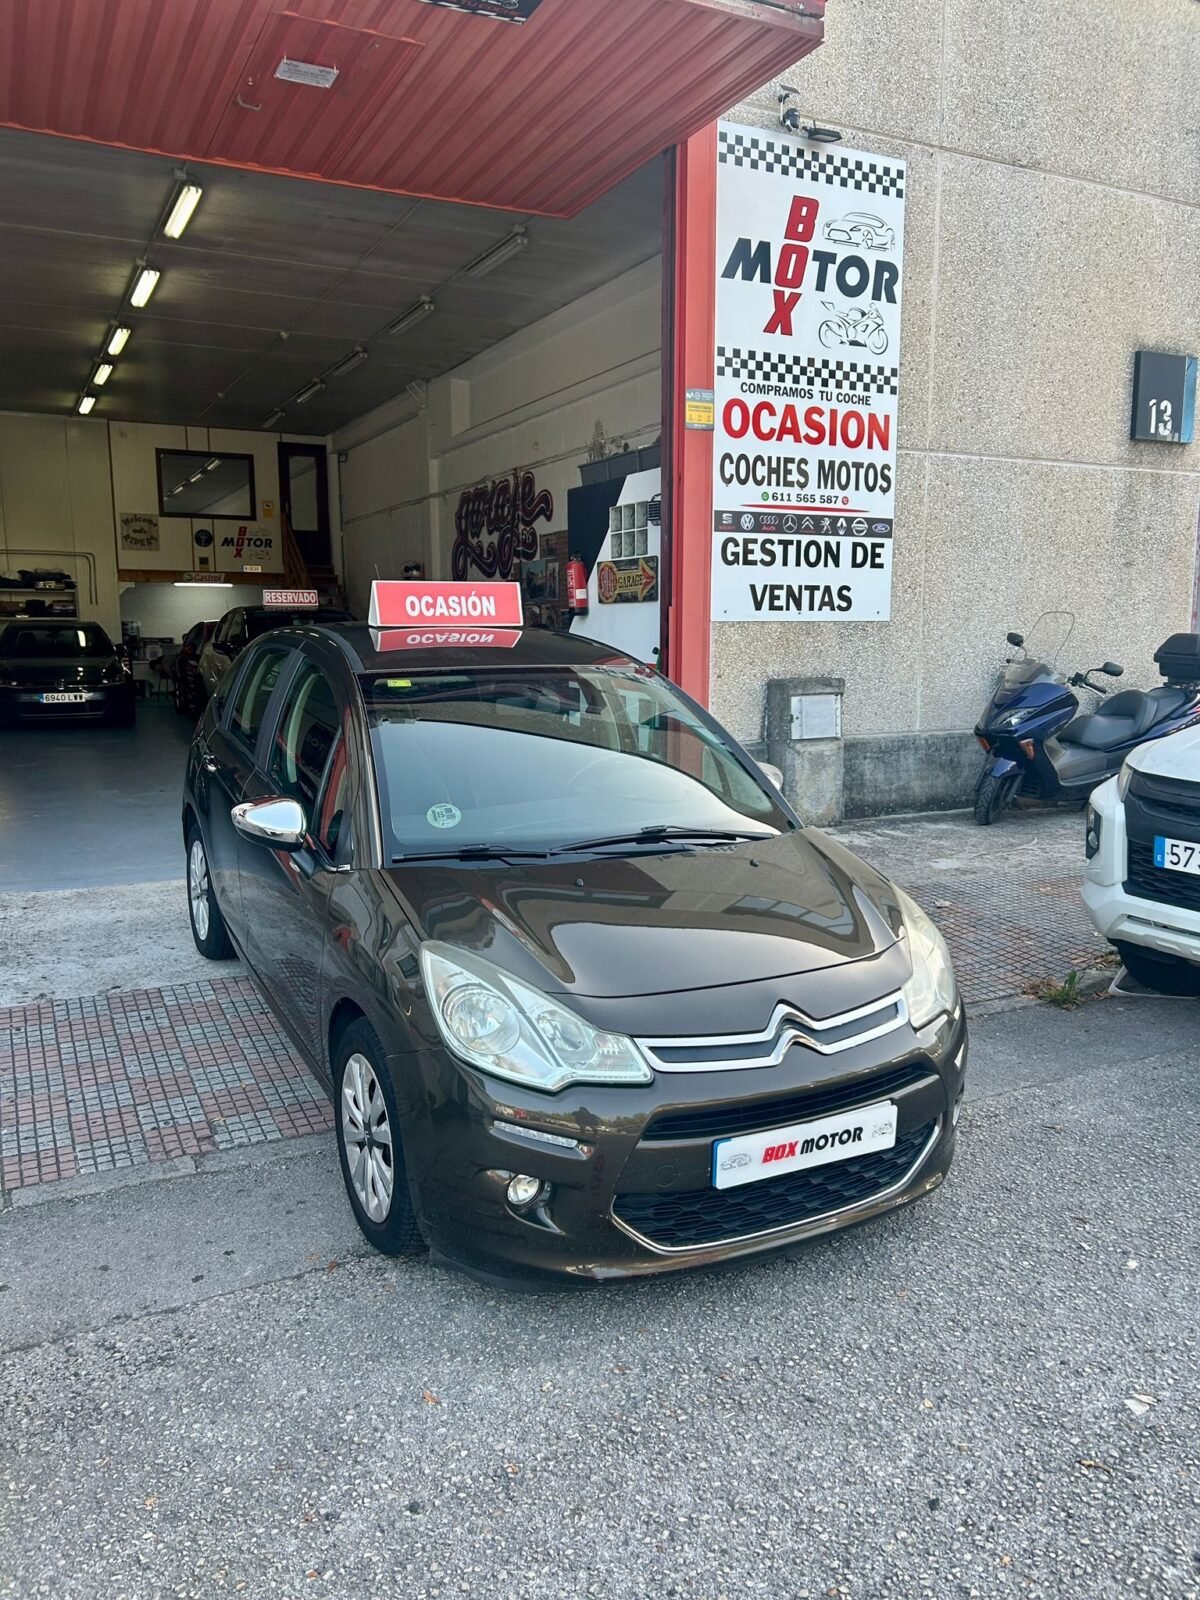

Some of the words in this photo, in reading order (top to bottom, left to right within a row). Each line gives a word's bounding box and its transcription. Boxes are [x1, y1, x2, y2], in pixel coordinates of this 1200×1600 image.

[721, 237, 899, 304] MOTOR
[763, 195, 820, 336] BOX
[740, 381, 814, 400] COMPRAMOS
[819, 390, 833, 402] TU
[836, 392, 871, 406] COCHE
[722, 398, 891, 451] OCASION
[1149, 399, 1172, 435] 13
[719, 452, 809, 489] COCHES
[817, 459, 892, 494] MOTOS
[772, 492, 792, 502] 611
[796, 493, 816, 504] 565
[819, 495, 839, 505] 587
[221, 537, 273, 548] MOTOR
[720, 537, 841, 568] GESTION
[851, 542, 885, 569] DE
[265, 592, 316, 603] RESERVADO
[405, 591, 496, 617] OCASIÓN
[749, 584, 852, 612] VENTAS
[45, 694, 66, 702] 6940
[761, 1140, 799, 1163] BOX
[800, 1126, 863, 1155] MOTOR
